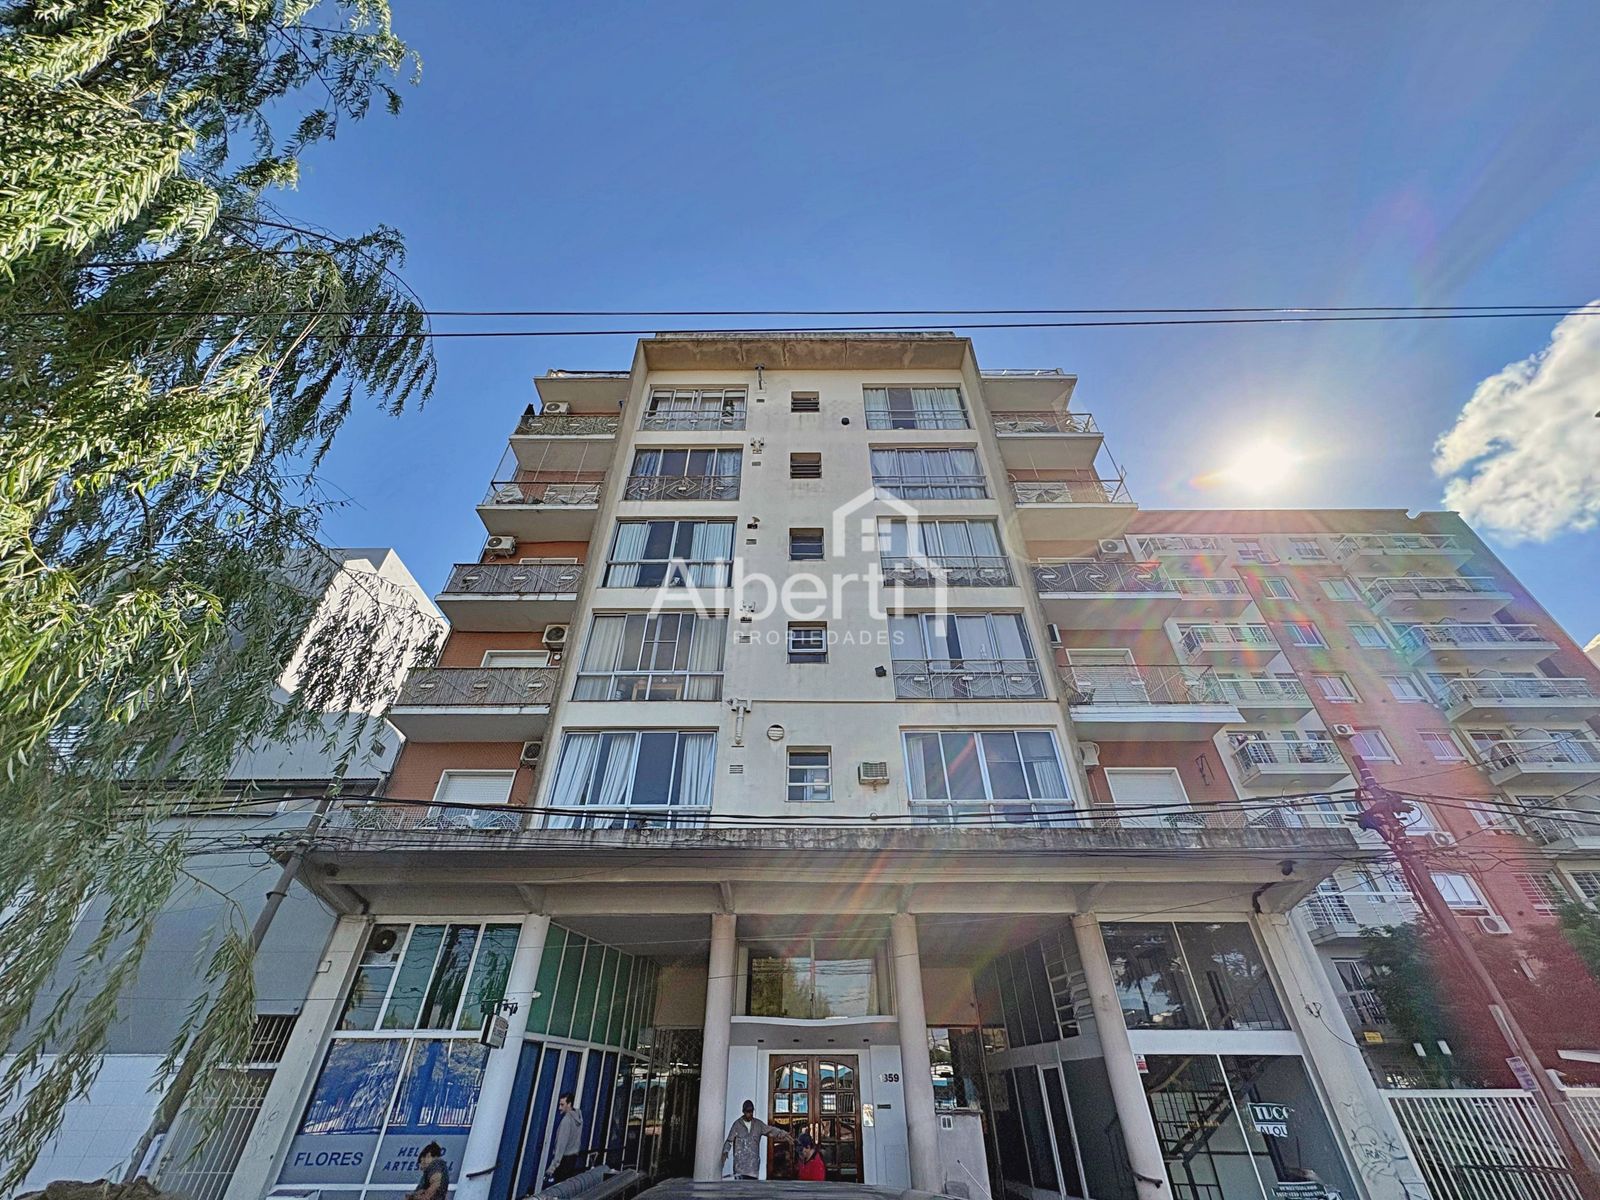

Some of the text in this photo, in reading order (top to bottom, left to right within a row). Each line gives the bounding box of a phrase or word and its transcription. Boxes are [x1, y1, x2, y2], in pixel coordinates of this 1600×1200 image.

[1253, 1106, 1295, 1120] TUCC
[397, 1146, 447, 1157] HELO
[294, 1151, 364, 1167] FLORES
[383, 1160, 454, 1172] ARTESL
